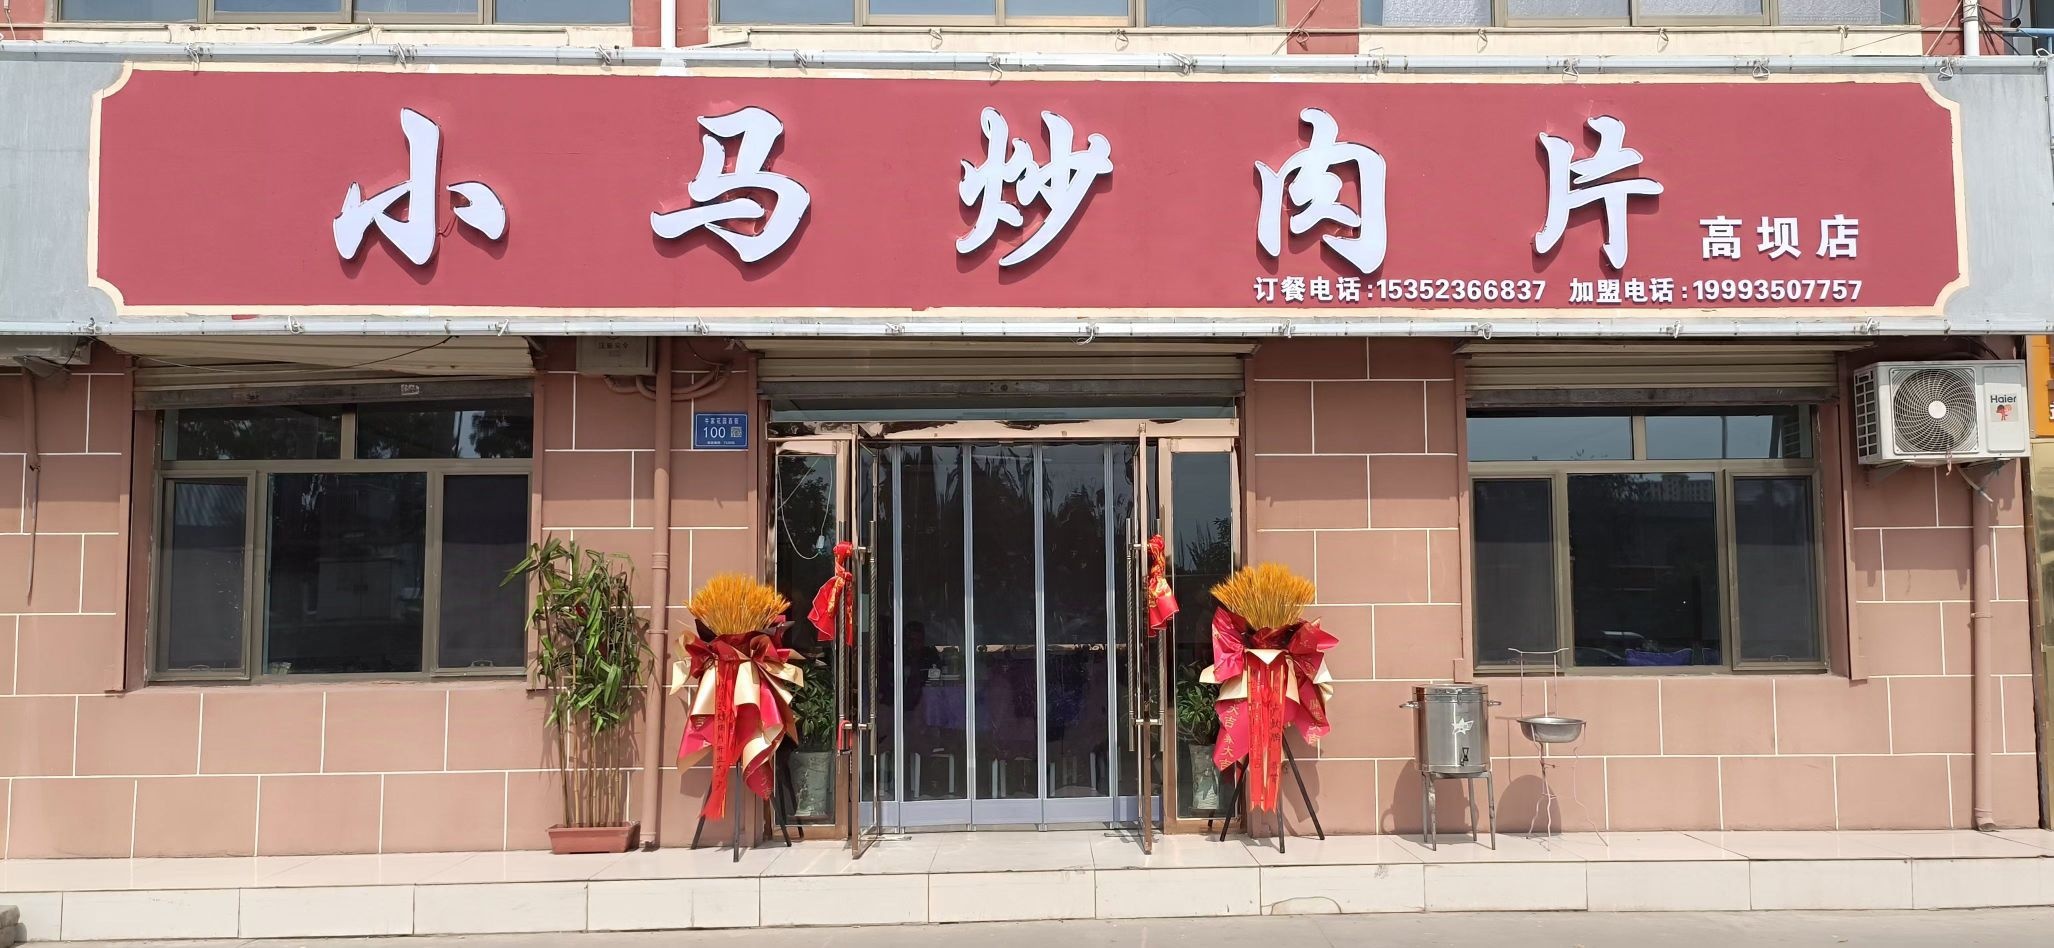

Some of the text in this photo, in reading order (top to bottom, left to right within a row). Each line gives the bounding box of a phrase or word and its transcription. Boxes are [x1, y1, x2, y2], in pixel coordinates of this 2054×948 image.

[333, 106, 1664, 273] 小马炒肉片
[1699, 214, 1859, 259] 高坝店
[1253, 276, 1863, 303] 订餐电话:15352366837 加盟电话:19993507757
[1990, 394, 2016, 403] Haier
[703, 426, 726, 439] 100
